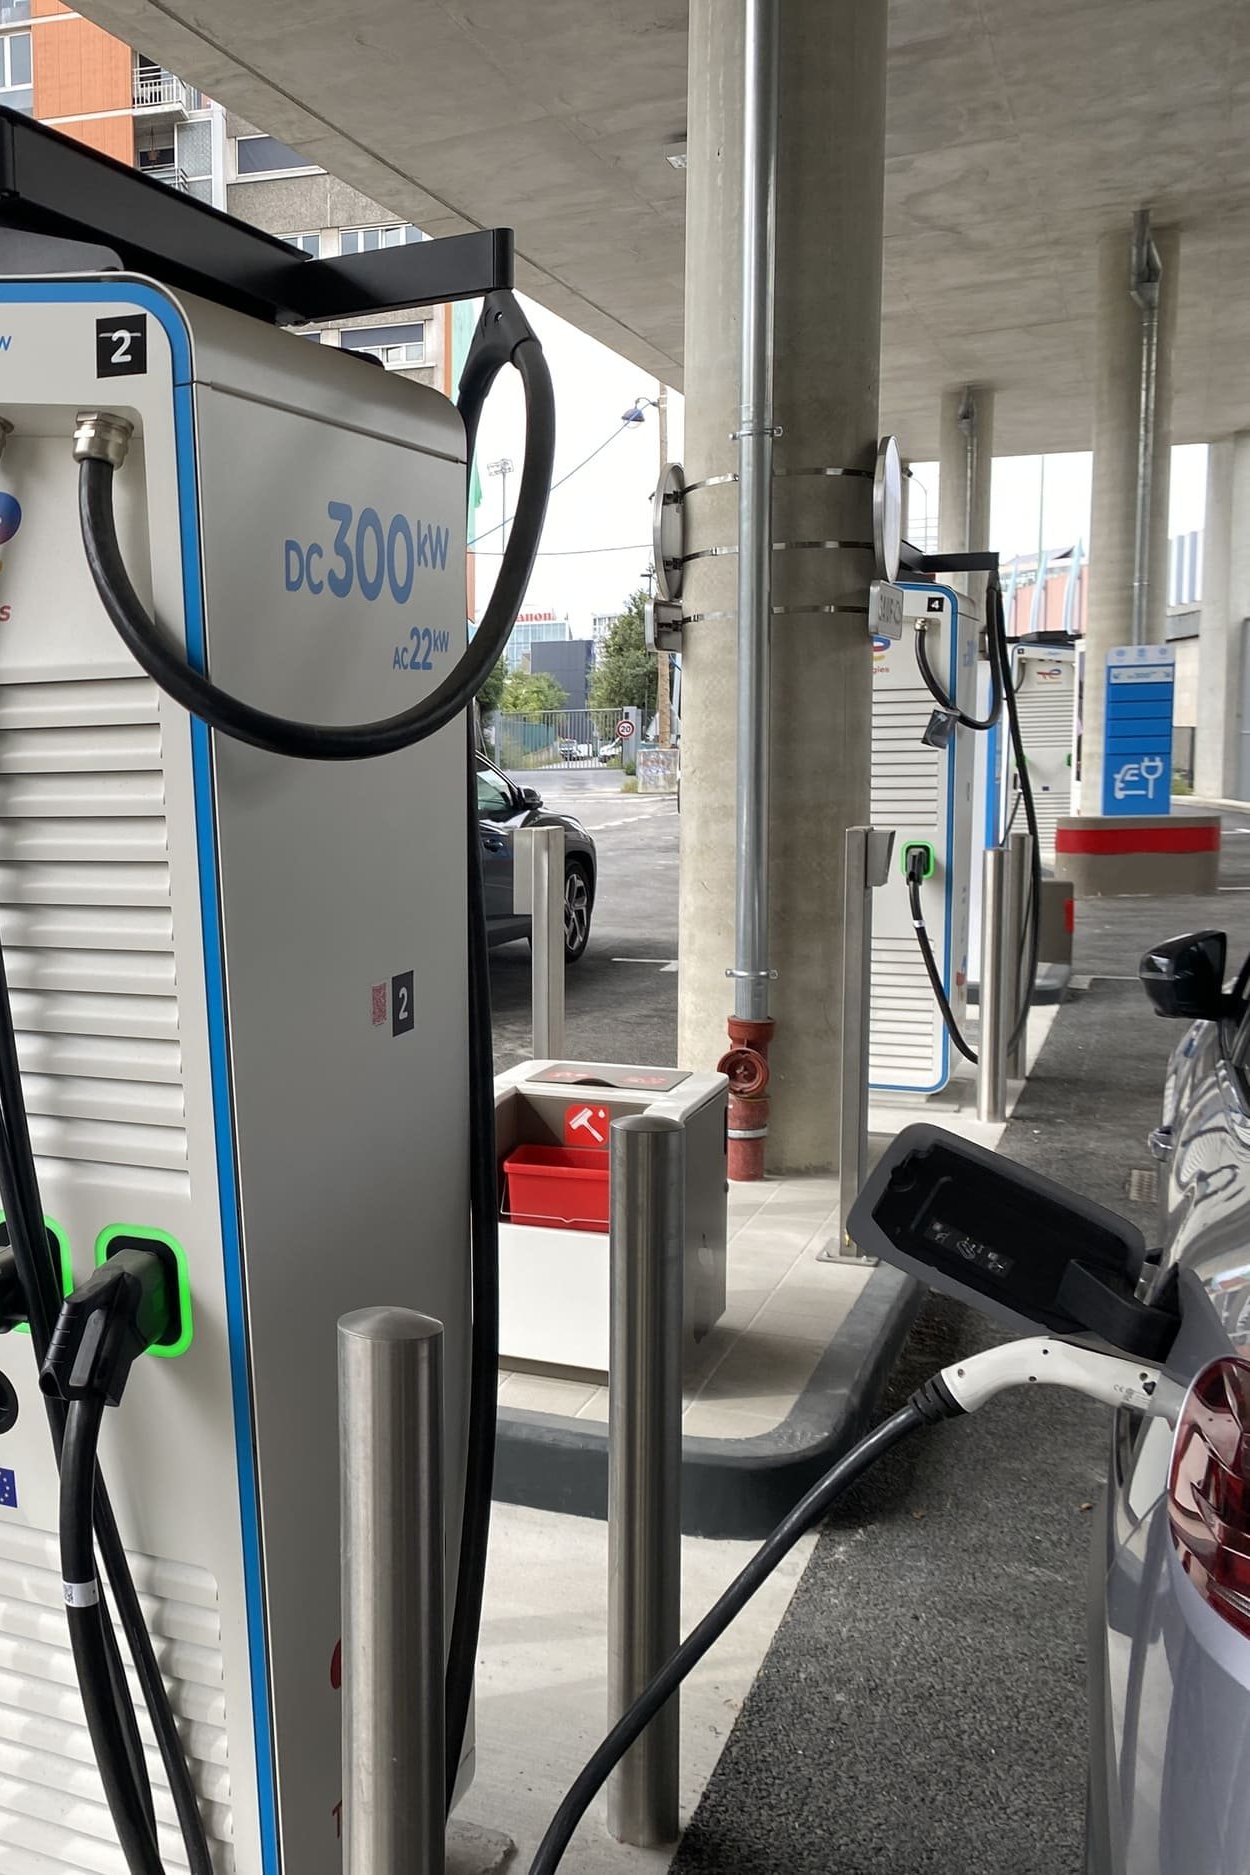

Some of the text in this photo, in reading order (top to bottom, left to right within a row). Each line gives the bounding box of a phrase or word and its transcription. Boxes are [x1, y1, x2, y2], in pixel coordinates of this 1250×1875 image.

[111, 329, 132, 363] 2
[931, 600, 940, 610] 4
[516, 612, 552, 622] anon
[621, 725, 631, 733] 20
[399, 987, 408, 1020] 2
